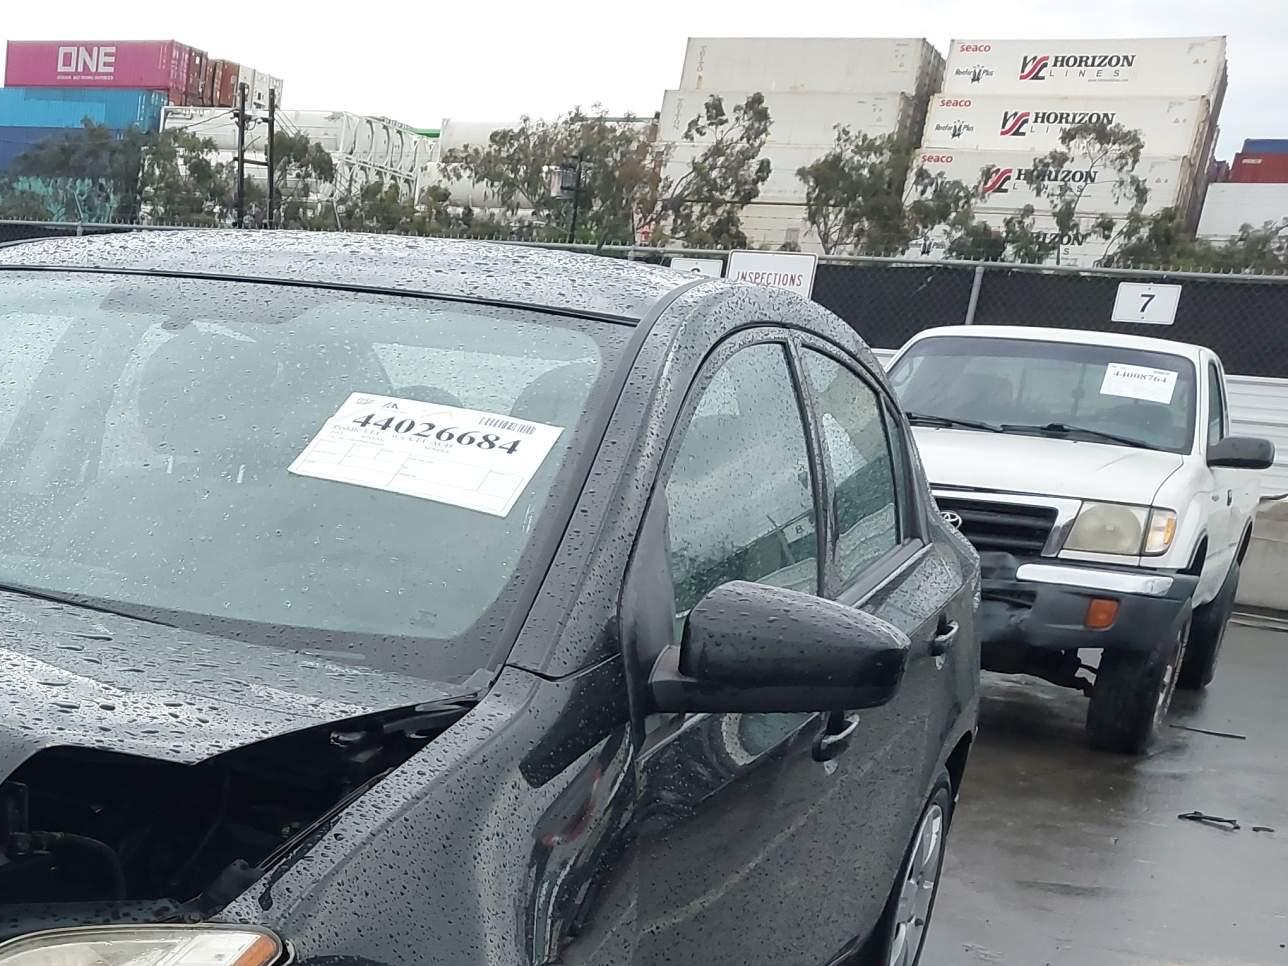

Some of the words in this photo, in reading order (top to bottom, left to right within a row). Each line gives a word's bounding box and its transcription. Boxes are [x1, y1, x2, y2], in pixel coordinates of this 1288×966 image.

[959, 44, 992, 53] seaco
[57, 46, 117, 73] ONE
[1052, 54, 1137, 68] HORIZON
[1049, 69, 1121, 78] LINES
[939, 99, 972, 108] seaco
[1032, 111, 1117, 125] HORIZON
[921, 154, 954, 164] seaco
[735, 270, 804, 288] INSPECTIONS
[1139, 293, 1156, 313] 7
[352, 412, 522, 455] 44026684
